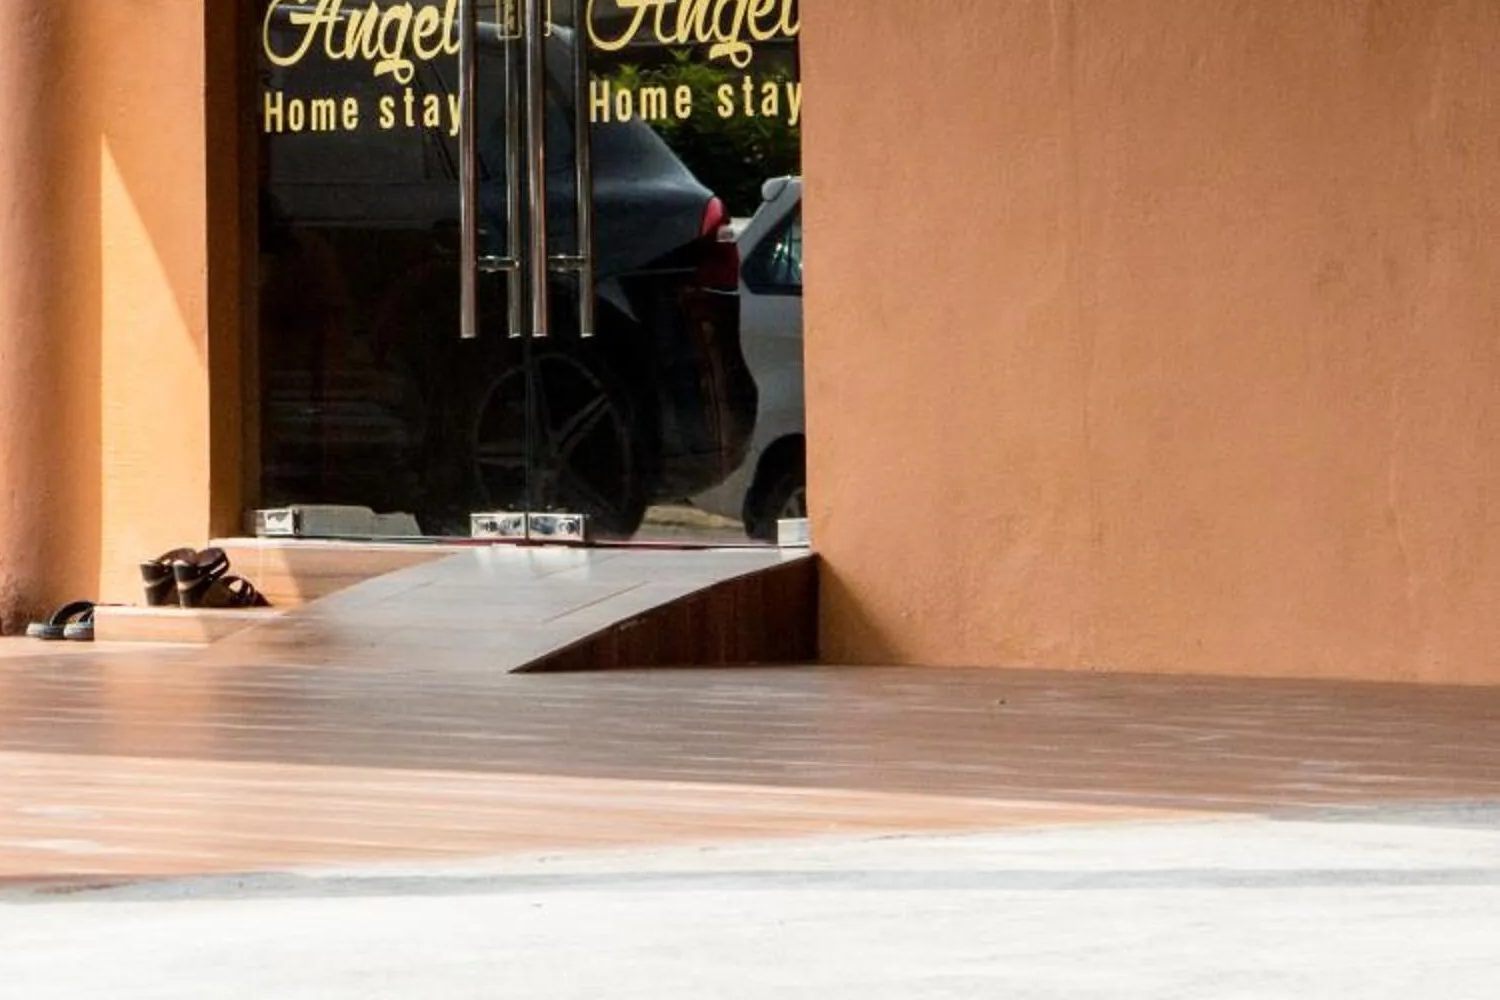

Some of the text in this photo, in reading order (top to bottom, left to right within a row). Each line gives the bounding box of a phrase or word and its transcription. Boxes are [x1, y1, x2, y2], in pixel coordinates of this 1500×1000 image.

[264, 87, 461, 137] Home stay
[589, 75, 801, 126] Home stay
